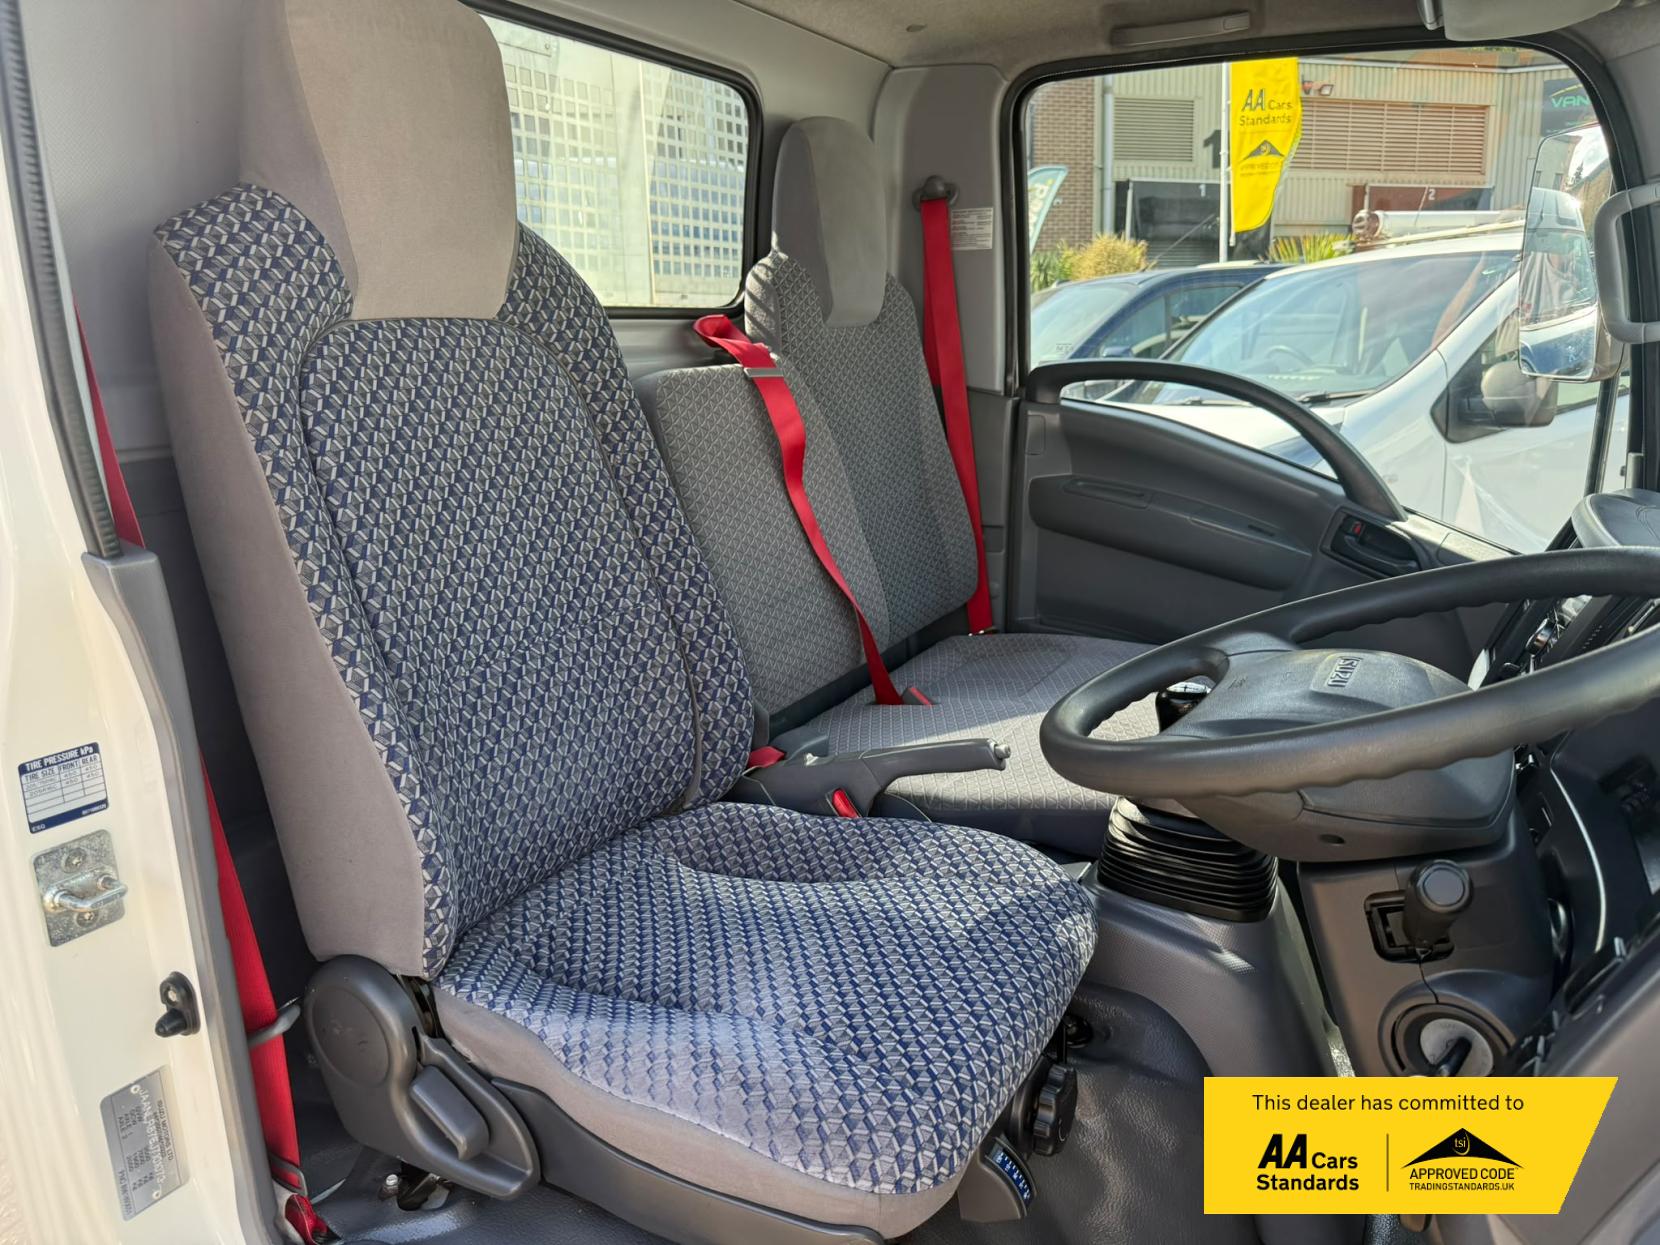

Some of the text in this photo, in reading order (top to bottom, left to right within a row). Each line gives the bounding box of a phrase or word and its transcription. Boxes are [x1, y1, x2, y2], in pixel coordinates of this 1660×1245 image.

[1242, 89, 1293, 112] AA Cars
[1239, 113, 1292, 126] Standards
[1428, 188, 1436, 200] 2
[1327, 656, 1363, 688] ISUZU
[25, 760, 42, 772] TIRE
[43, 749, 79, 767] PRESSURE
[81, 755, 98, 765] REAR
[41, 767, 56, 777] SIZE
[60, 761, 79, 772] FRONT
